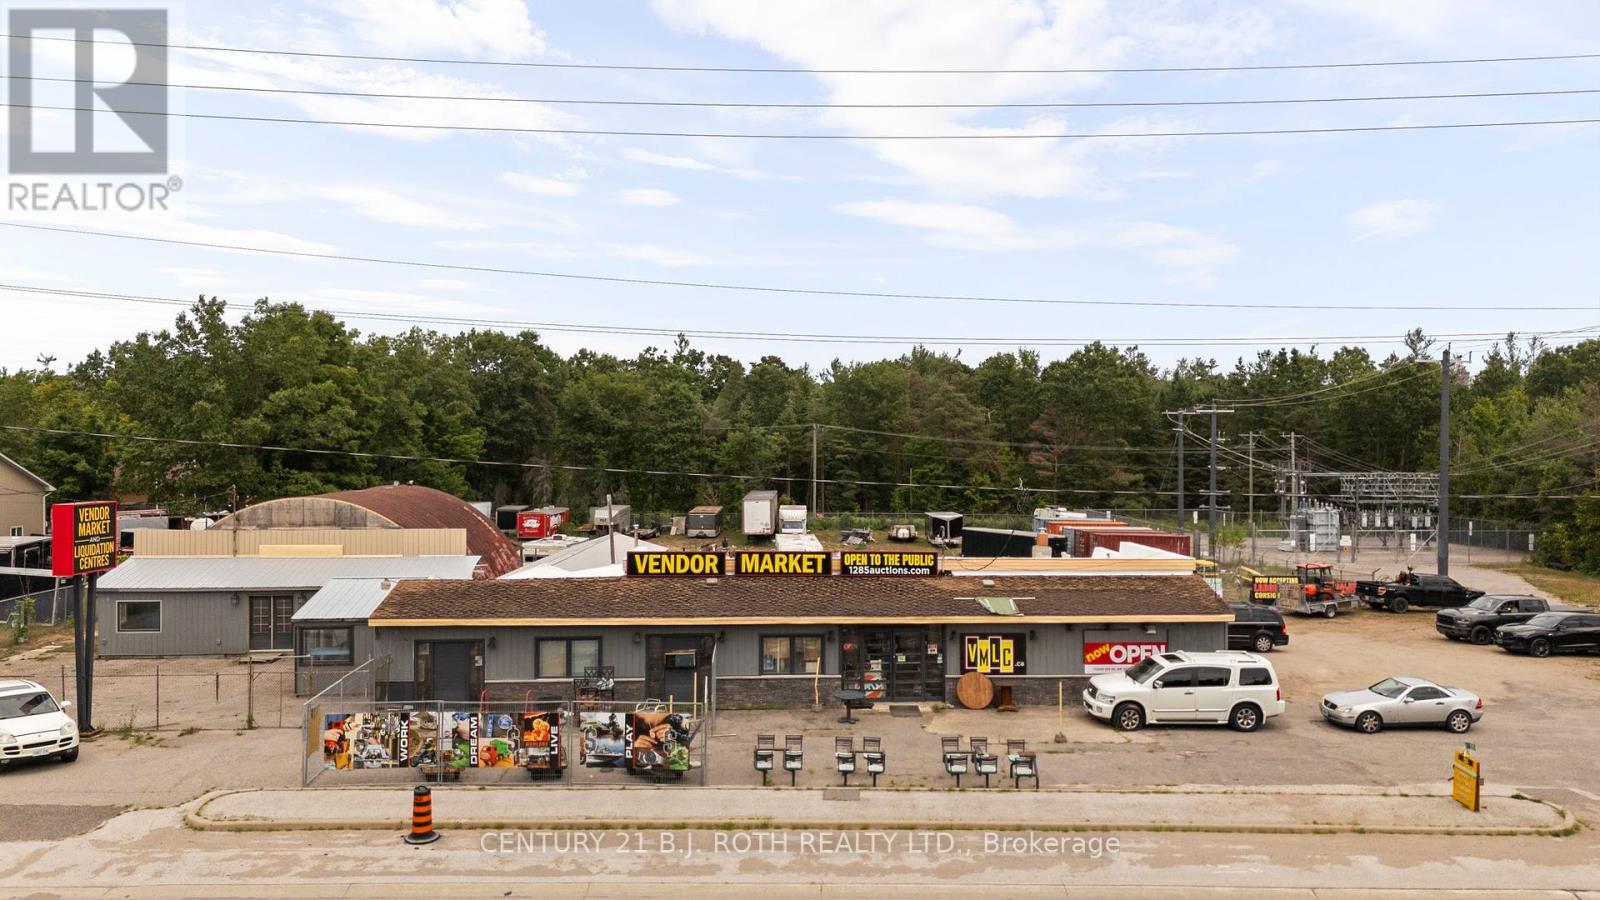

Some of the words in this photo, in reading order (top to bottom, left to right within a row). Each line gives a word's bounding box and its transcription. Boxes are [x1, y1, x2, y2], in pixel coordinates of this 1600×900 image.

[79, 506, 110, 522] VENDOR
[78, 520, 111, 537] MARKET
[74, 541, 115, 558] LIQUIDATION
[79, 554, 110, 570] CENTRES
[634, 554, 719, 574] VENDOR
[741, 554, 826, 573] MARKET
[844, 553, 868, 566] OPEN
[870, 553, 881, 566] TO
[883, 553, 900, 566] THE
[902, 553, 934, 566] PUBLIC
[848, 566, 930, 575] 1285auctions.com
[967, 642, 1012, 667] VMLC
[1085, 643, 1110, 663] now
[400, 719, 409, 762] WORK
[470, 716, 478, 765] DREAM
[625, 724, 634, 759] PLAY
